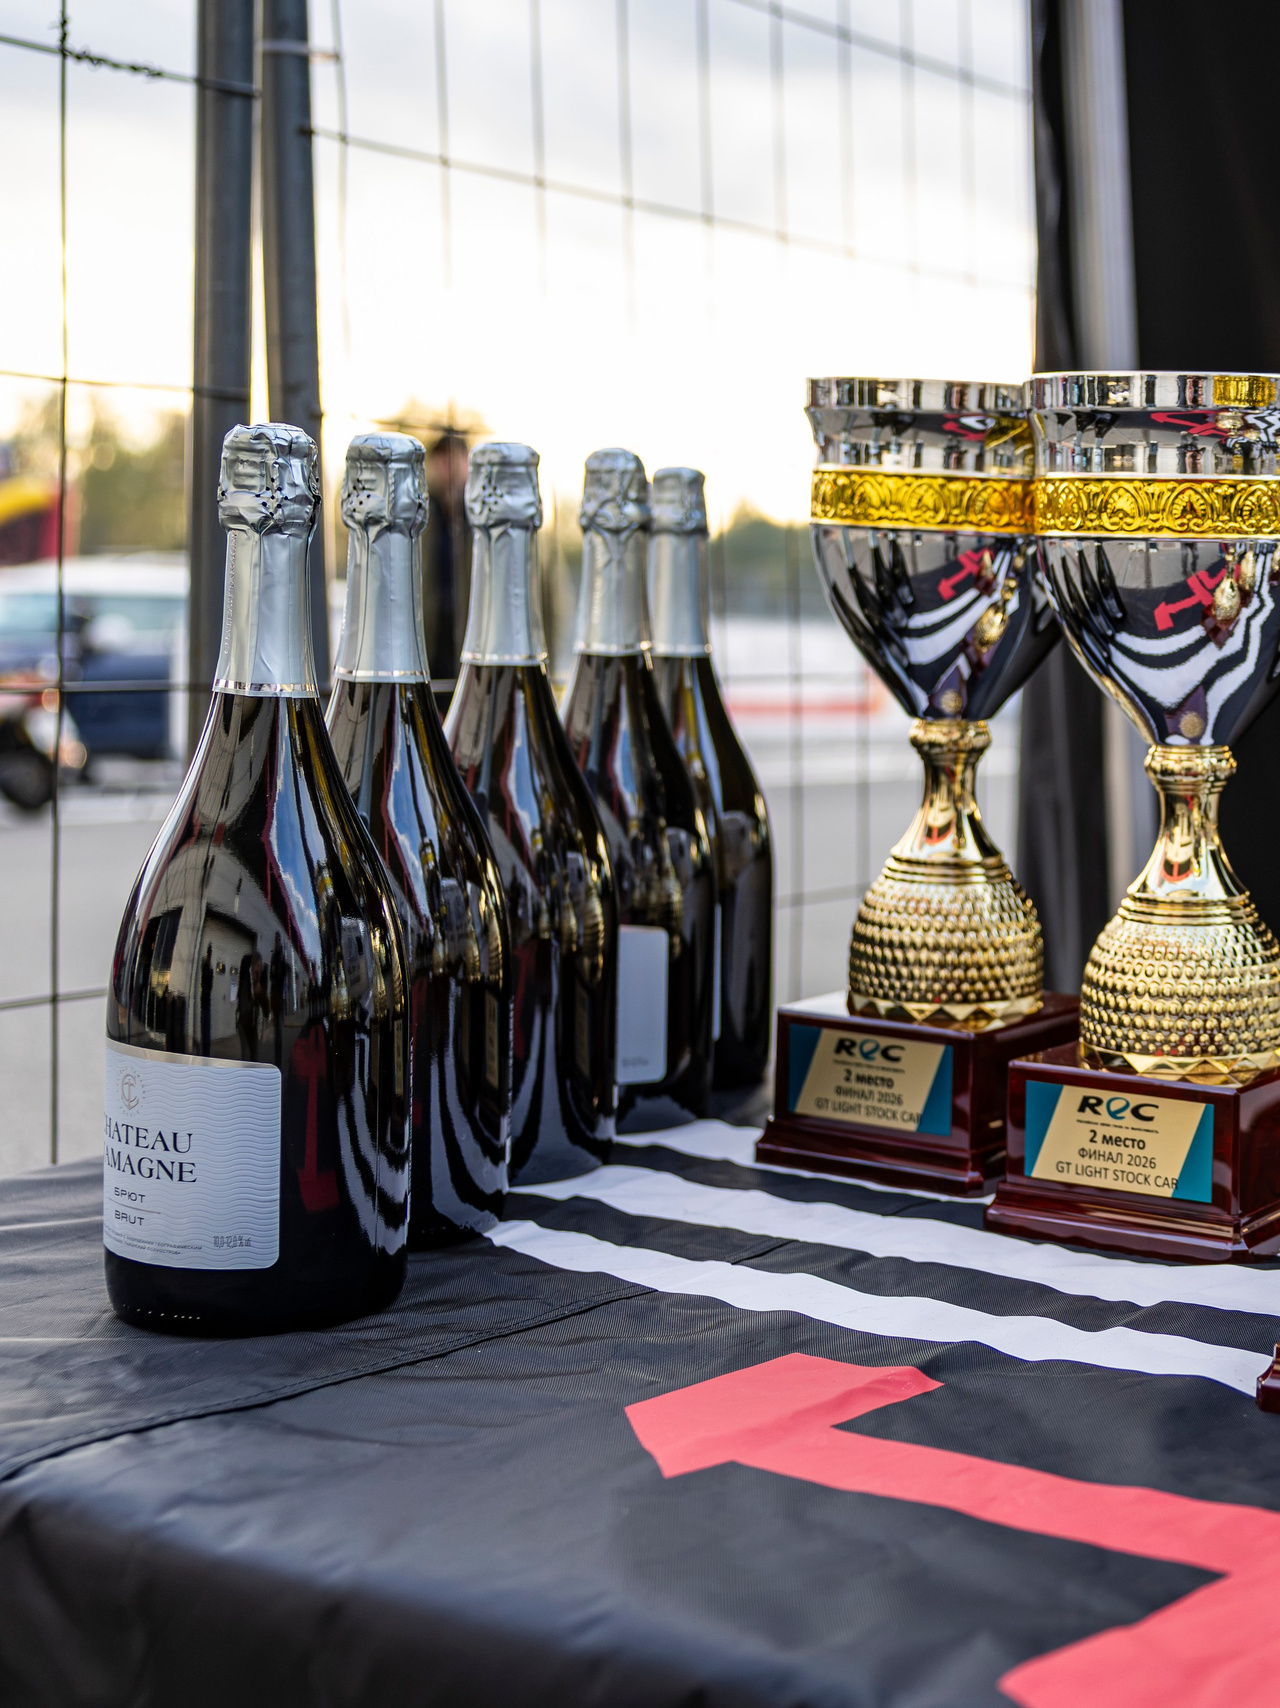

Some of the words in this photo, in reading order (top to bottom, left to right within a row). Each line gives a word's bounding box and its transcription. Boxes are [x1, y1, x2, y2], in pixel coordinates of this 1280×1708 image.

[843, 1069, 852, 1082] 2
[856, 1072, 894, 1088] место
[835, 1086, 874, 1102] ФИНАЛ
[877, 1093, 903, 1106] 2026
[815, 1097, 829, 1111] GT
[832, 1101, 861, 1115] LIGHT
[865, 1105, 898, 1121] STOCK
[105, 1113, 193, 1154] HATEAU
[1089, 1130, 1098, 1143] 2
[1102, 1134, 1146, 1150] место
[105, 1143, 197, 1183] AMAGNE
[1078, 1147, 1123, 1165] ФИНАЛ
[1127, 1154, 1156, 1169] 2026
[1055, 1160, 1072, 1174] GT
[1075, 1165, 1109, 1180] LIGHT
[1112, 1170, 1151, 1186] STOCK
[114, 1186, 146, 1203] БРЮТ
[114, 1209, 145, 1226] BRUT
